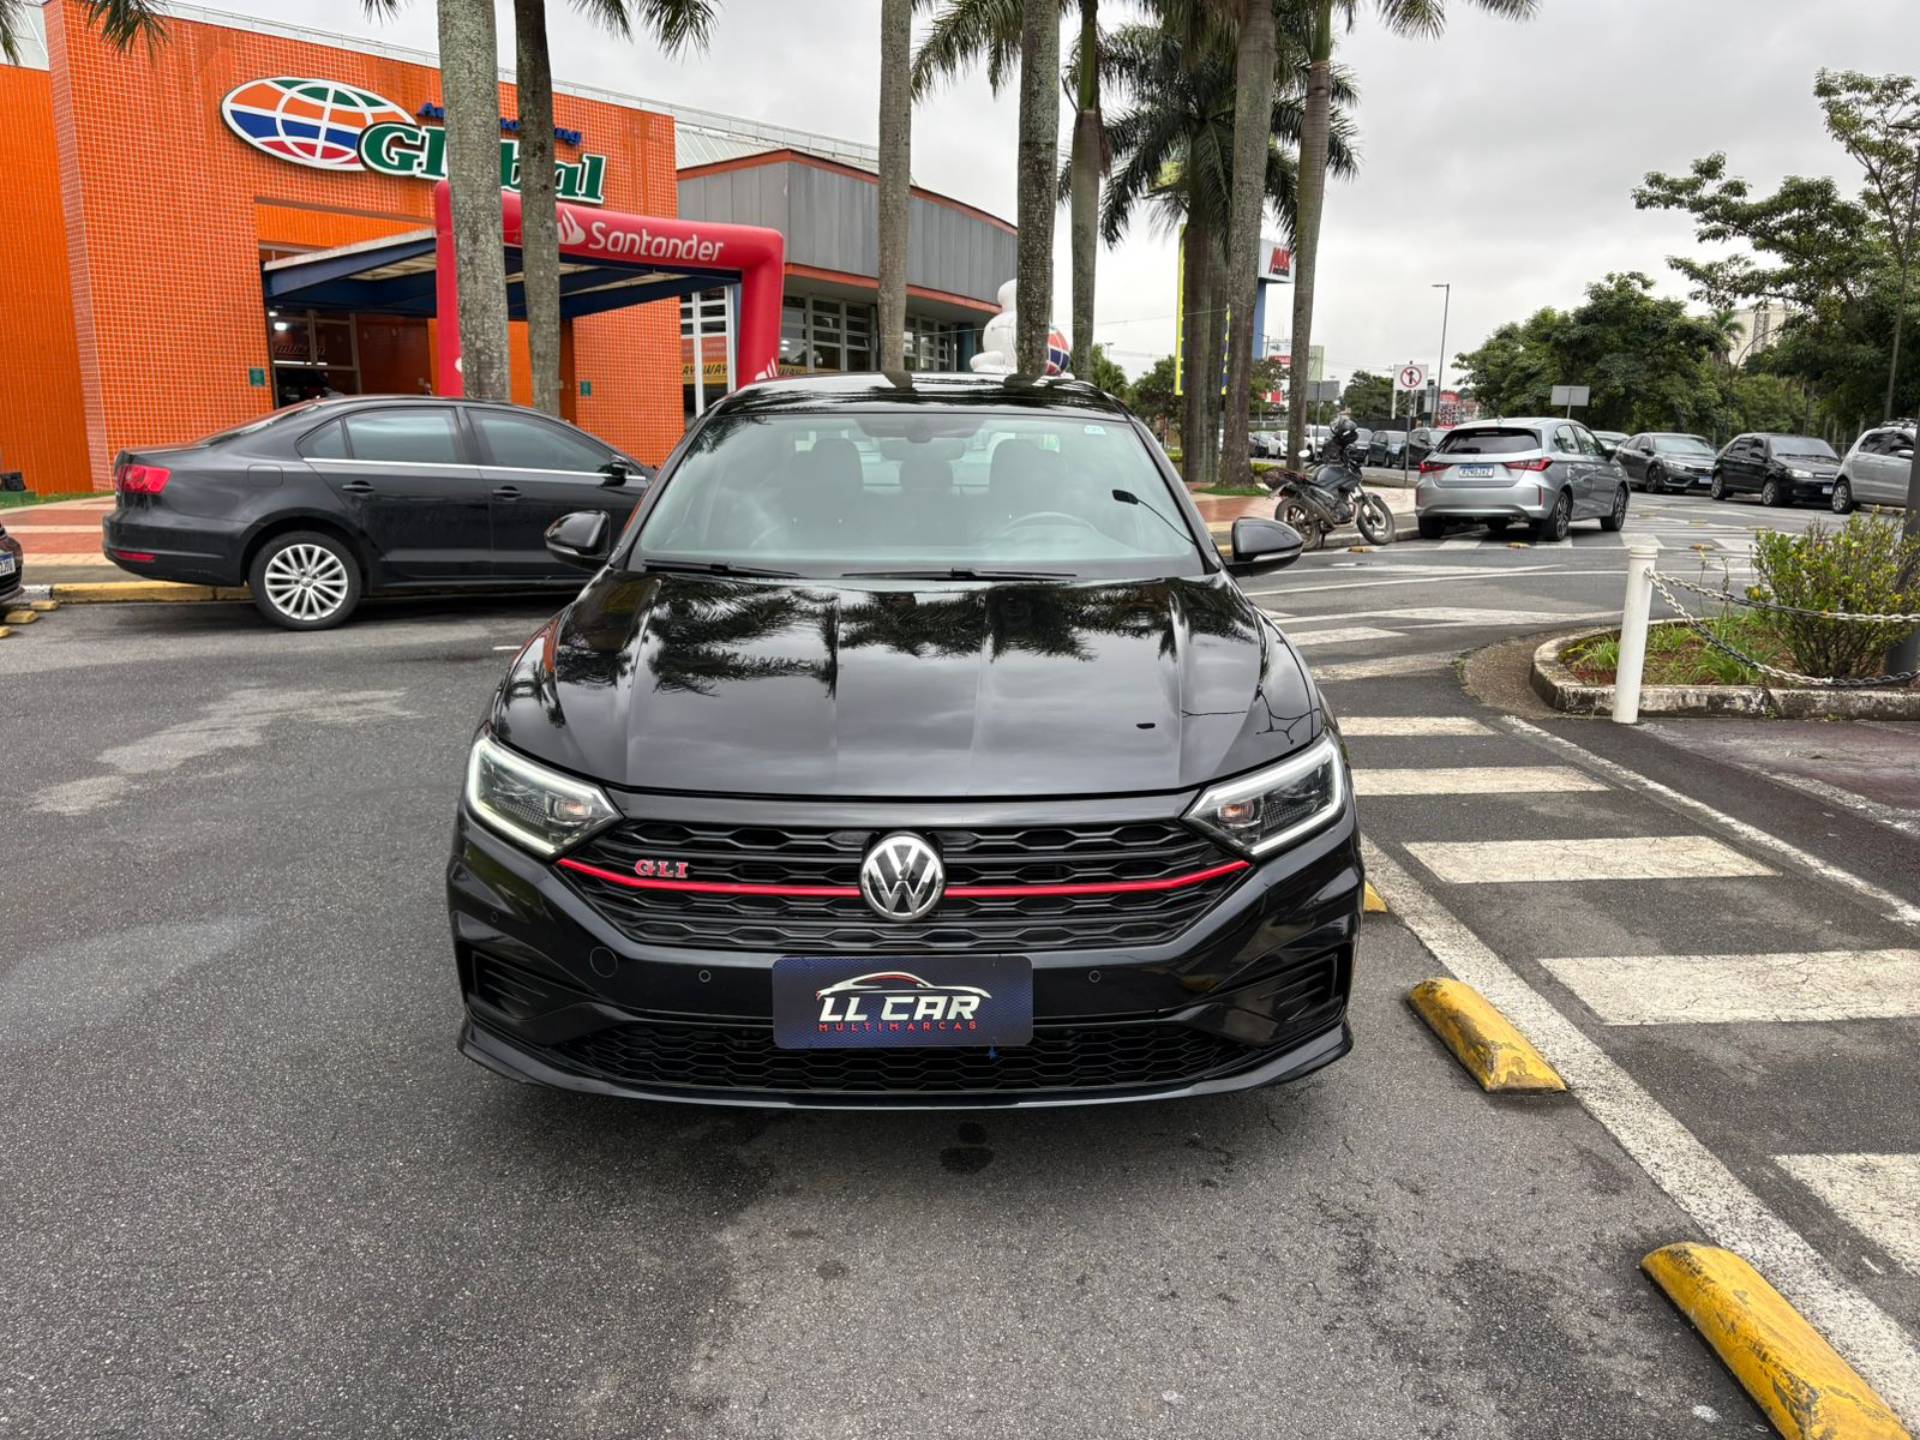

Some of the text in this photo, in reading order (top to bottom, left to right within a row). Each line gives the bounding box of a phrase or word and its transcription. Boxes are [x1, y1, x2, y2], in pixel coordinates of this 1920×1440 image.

[588, 221, 724, 262] Santander
[634, 859, 689, 878] GLI
[819, 995, 981, 1022] LL CAR
[819, 1021, 977, 1032] MULTIMARCAS
